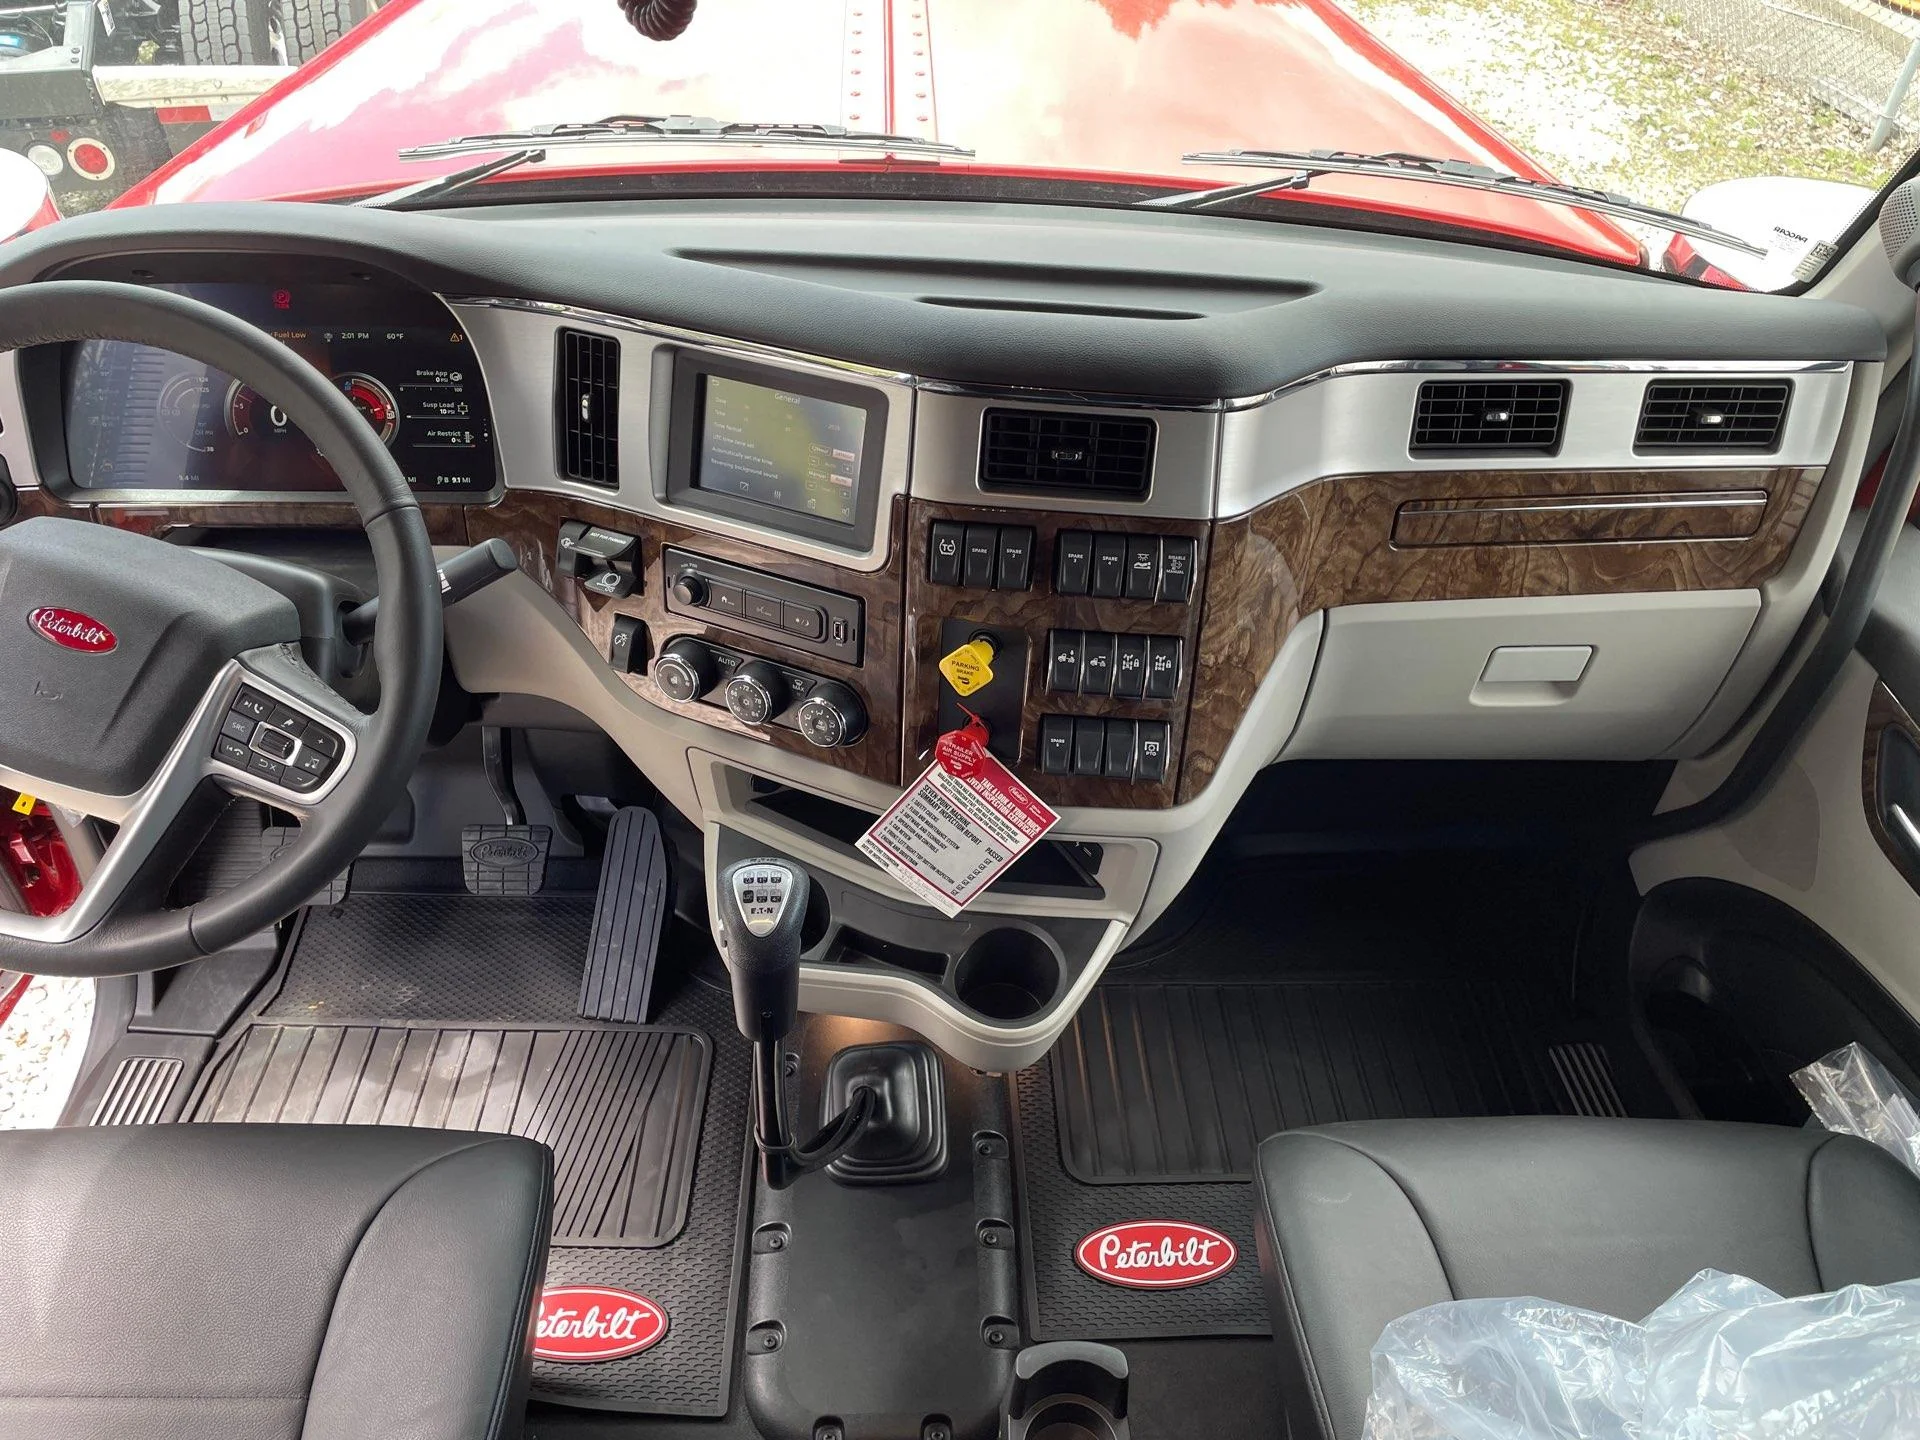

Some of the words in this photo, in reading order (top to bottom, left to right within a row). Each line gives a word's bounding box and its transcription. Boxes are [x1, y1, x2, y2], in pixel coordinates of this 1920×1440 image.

[341, 332, 355, 340] 2:01
[357, 332, 370, 340] PM
[774, 393, 801, 405] General
[711, 446, 744, 460] Automatically
[734, 464, 763, 476] background
[1102, 555, 1119, 563] SPARE
[37, 610, 104, 645] Peterbilt
[718, 656, 736, 667] AUTO
[951, 660, 980, 672] PARKING
[956, 668, 974, 676] BRAKE
[792, 684, 805, 692] MAX
[232, 722, 246, 733] SRC
[942, 745, 953, 754] AIR
[953, 750, 977, 764] SUPPLY
[949, 742, 974, 756] TRAILER
[978, 776, 995, 792] TAKE
[990, 787, 999, 795] A
[993, 789, 1010, 805] LOOK
[1005, 800, 1016, 810] AT
[912, 798, 928, 812] SAFETY
[923, 808, 940, 823] CHECKS
[936, 771, 953, 787] QUALIFIED
[949, 783, 969, 801] TECHNICIAN
[974, 805, 984, 814] AND
[980, 810, 989, 819] HAS
[986, 815, 999, 828] PASSED
[996, 824, 1005, 832] OUR
[1002, 829, 1020, 845] STRINGENT
[939, 782, 953, 795] QUALITY
[971, 811, 984, 822] BELOW
[981, 819, 990, 827] FOR
[986, 823, 998, 833] MORE
[951, 778, 964, 789] TRUCK
[960, 785, 970, 795] HAS
[966, 791, 977, 801] BEEN
[973, 797, 992, 814] INSPECTED
[992, 814, 1001, 822] OUR
[998, 819, 1013, 832] TRAINED
[1009, 828, 1019, 837] AND
[980, 788, 1011, 816] INSPECTION
[1005, 810, 1037, 839] CERTIFICATE
[1010, 805, 1028, 821] YOUR
[916, 788, 943, 812] SUMMARY
[937, 807, 967, 833] INSPECTION
[962, 828, 982, 846] REPORT
[948, 806, 972, 828] MACHINE
[1022, 816, 1042, 834] TRUCK
[896, 816, 917, 835] OPERATION
[913, 831, 923, 840] AND
[919, 837, 939, 854] CONTROLS
[897, 828, 913, 841] REVIEW
[901, 811, 921, 828] SOFTWARE
[918, 825, 928, 834] AND
[924, 830, 948, 850] TECHNOLOGY
[907, 805, 920, 817] FLUID
[916, 813, 927, 822] AND
[923, 819, 948, 840] MAINTENANCE
[945, 837, 960, 850] SYSTEM
[860, 842, 871, 851] DATE
[870, 851, 891, 868] INSPECTION
[864, 838, 884, 854] INSPECTING
[880, 851, 900, 868] TECHNICIAN
[879, 834, 894, 846] ENGINE
[891, 843, 901, 852] AND
[897, 849, 919, 867] DRIVETRAIN
[983, 845, 1004, 863] PASSED
[934, 867, 955, 885] INSPECTION
[1099, 1234, 1221, 1270] Peterbilt
[537, 1301, 651, 1340] eterbilt
